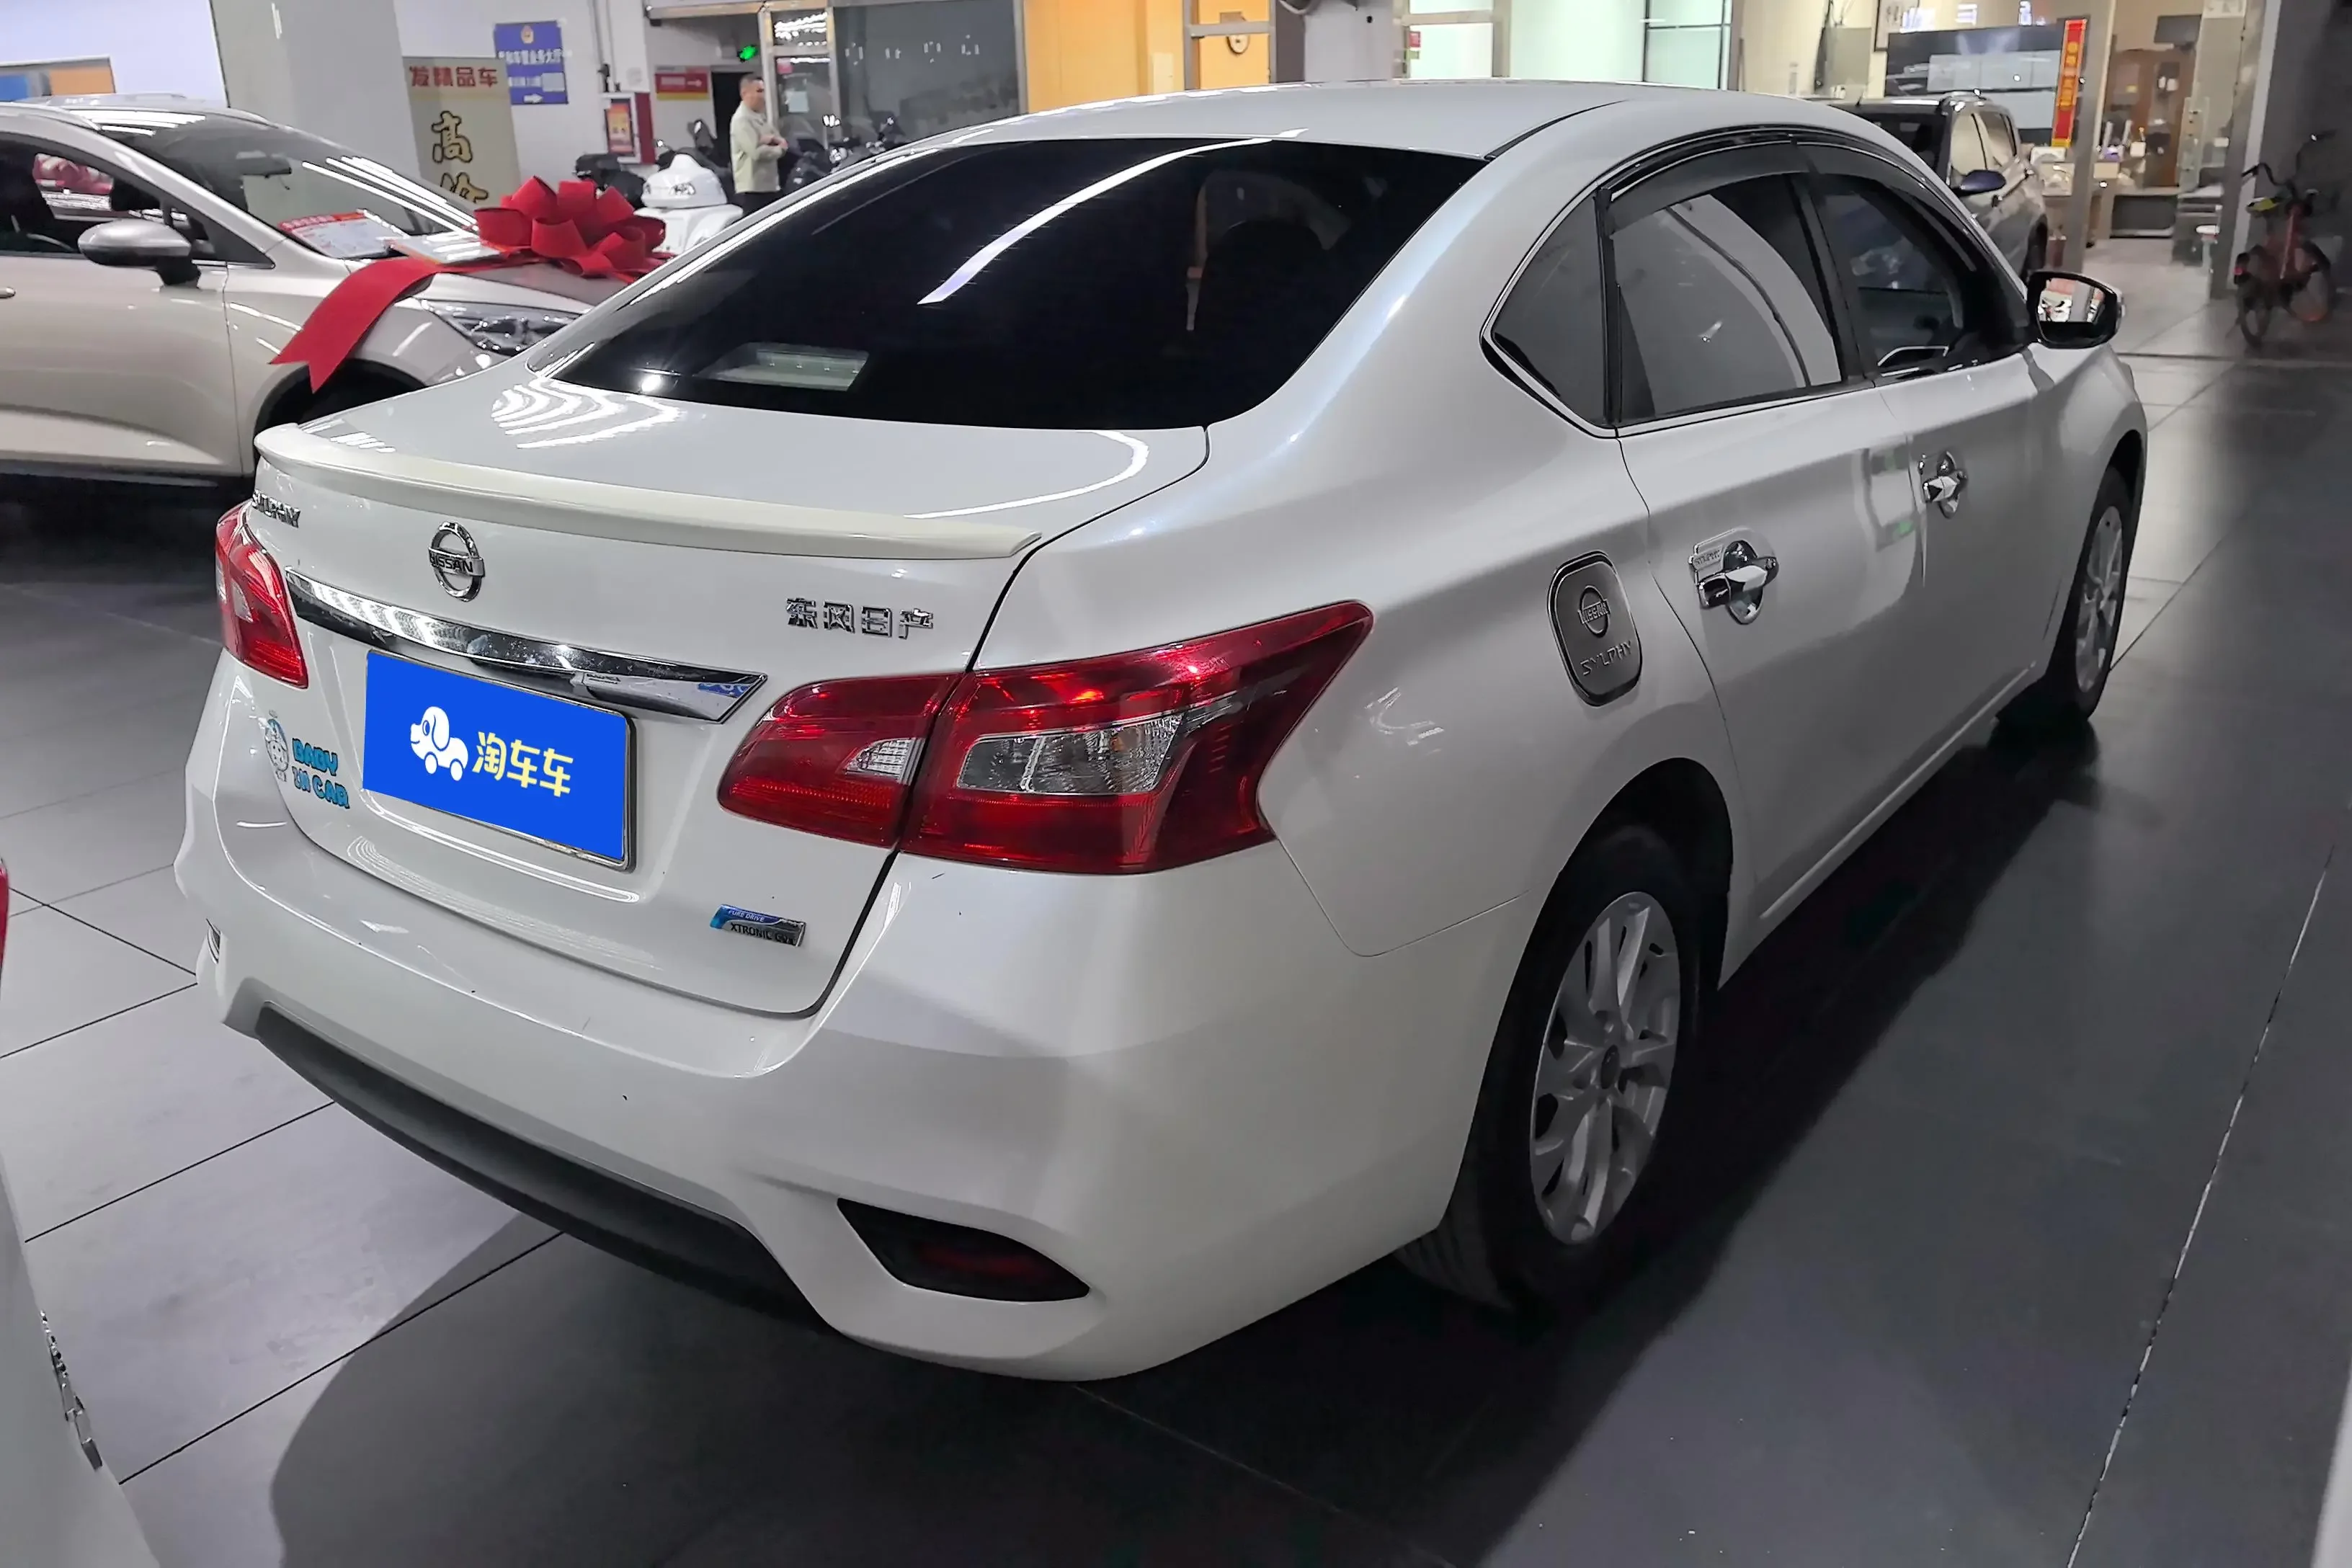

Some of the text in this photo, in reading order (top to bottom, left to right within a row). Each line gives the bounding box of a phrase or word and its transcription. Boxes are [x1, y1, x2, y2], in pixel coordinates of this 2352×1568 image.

[429, 550, 474, 575] NISSAN
[786, 597, 934, 640] 东风日产
[1579, 602, 1609, 624] NISSAN
[1580, 640, 1632, 676] SYLPHY
[292, 737, 338, 777] BABY
[312, 774, 350, 810] CAR
[728, 909, 765, 922] PURE DRIVE
[731, 922, 772, 940] XTRONIC
